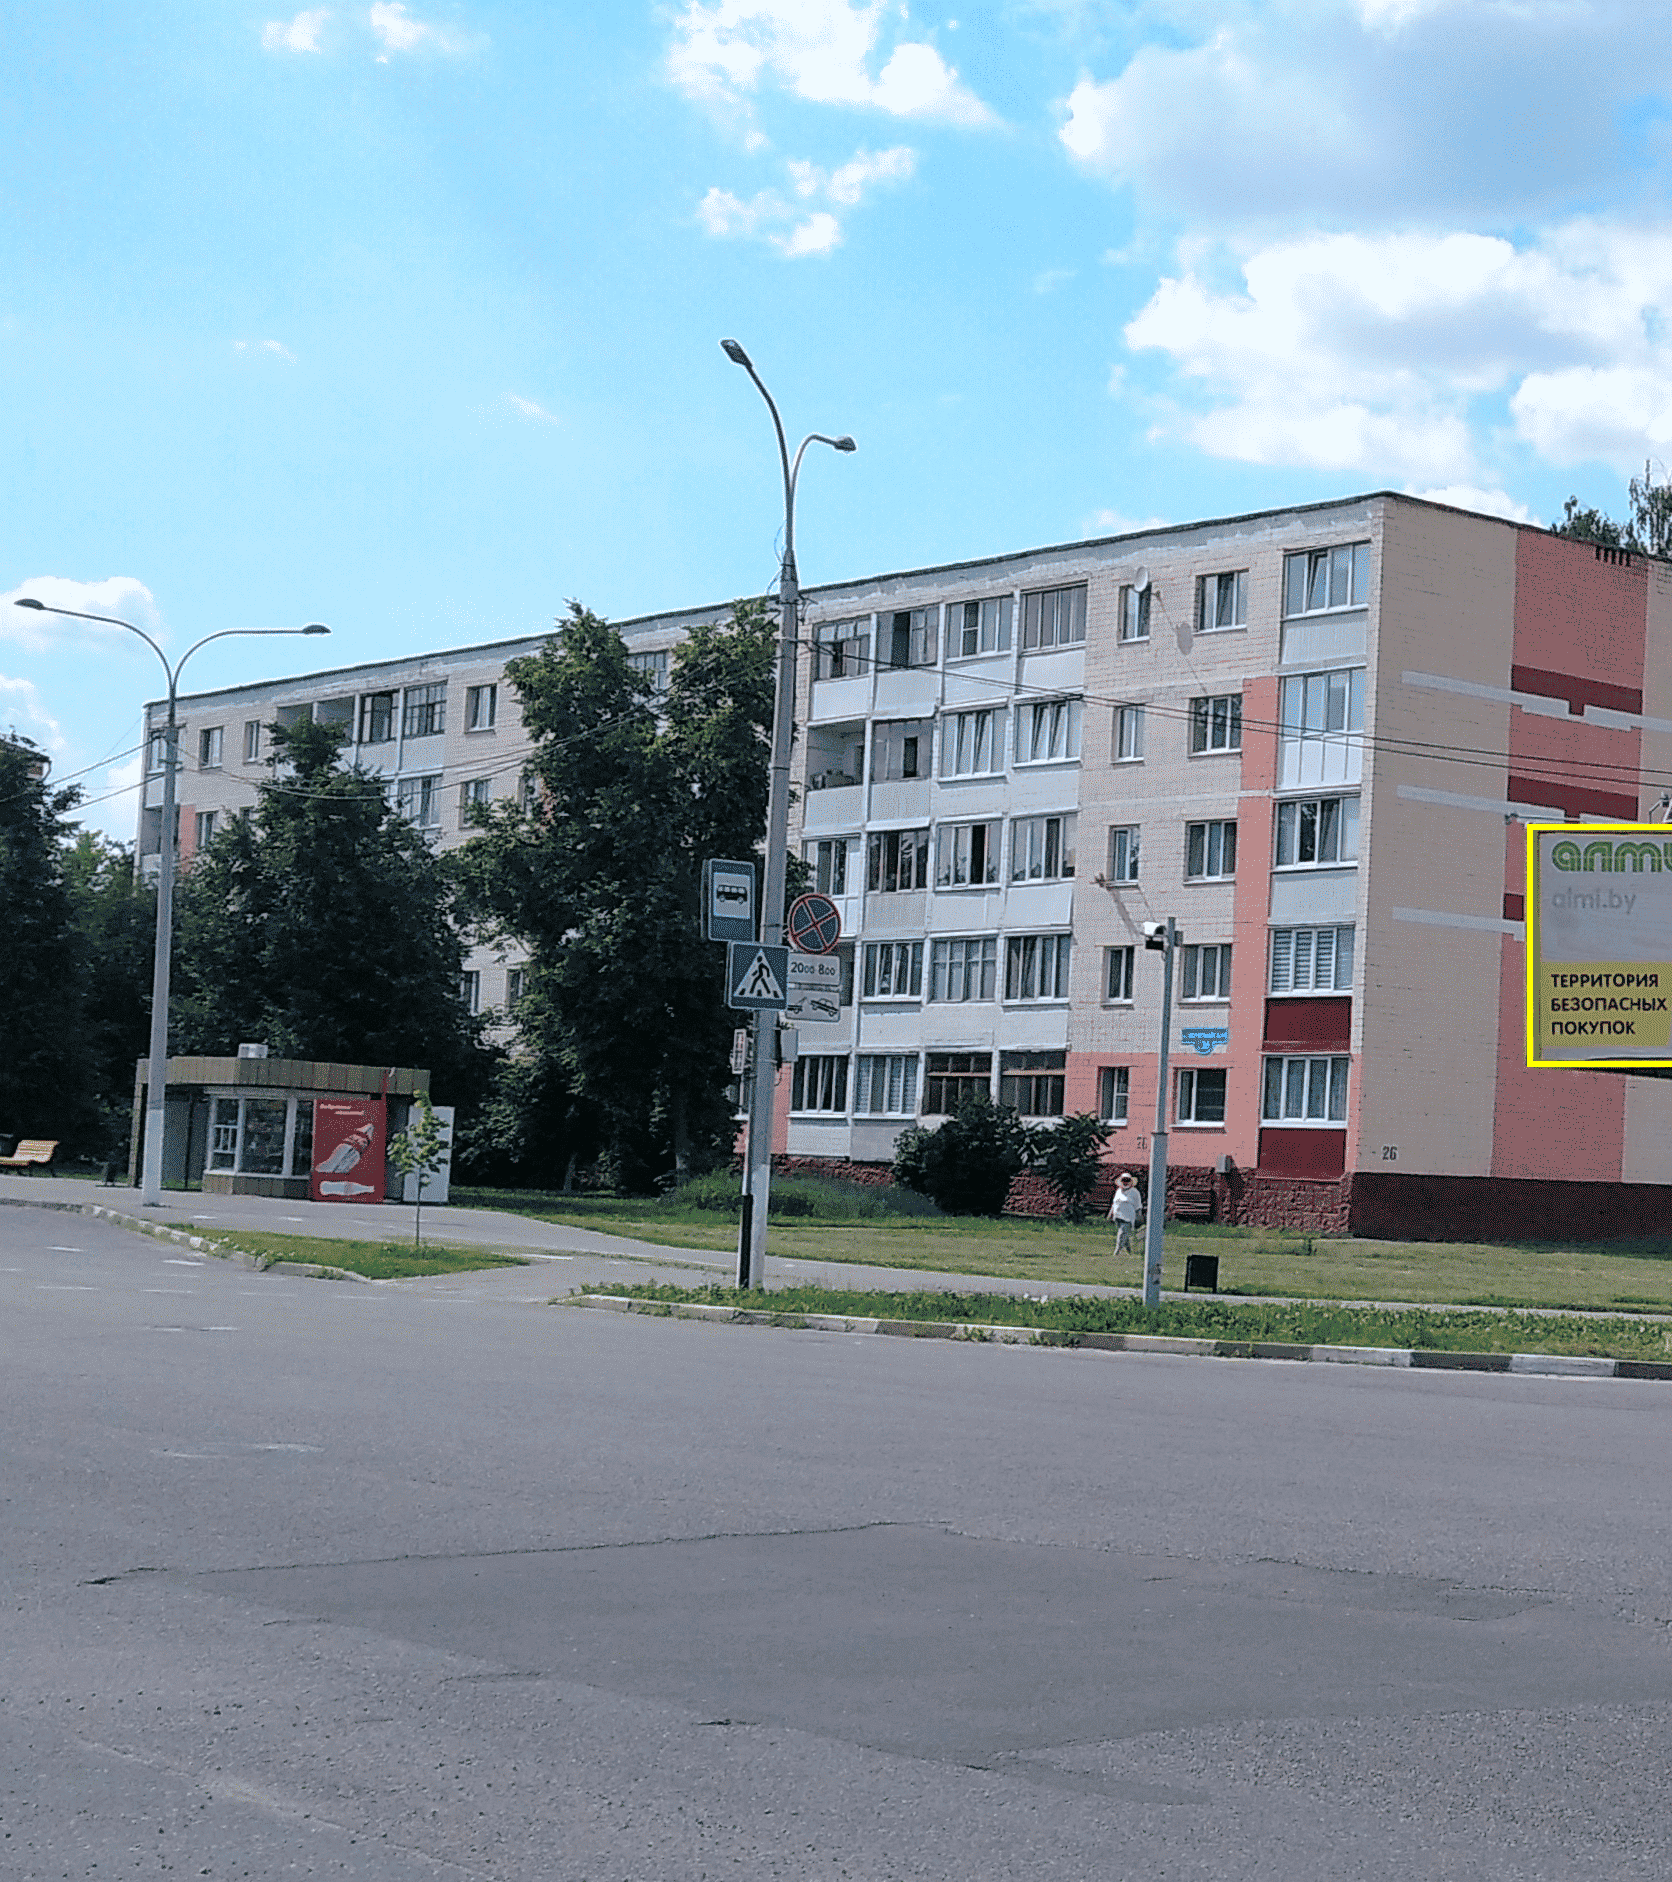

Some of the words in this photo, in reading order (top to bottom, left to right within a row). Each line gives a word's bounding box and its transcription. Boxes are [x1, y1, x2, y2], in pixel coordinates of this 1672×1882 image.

[1551, 887, 1637, 915] almi.by
[1551, 973, 1659, 988] ТЕРРИТОРИЯ
[1551, 997, 1667, 1011] БЕЗОПАСНЫХ
[1551, 1020, 1635, 1035] ПОКУПОК
[1382, 1145, 1397, 1160] 26
